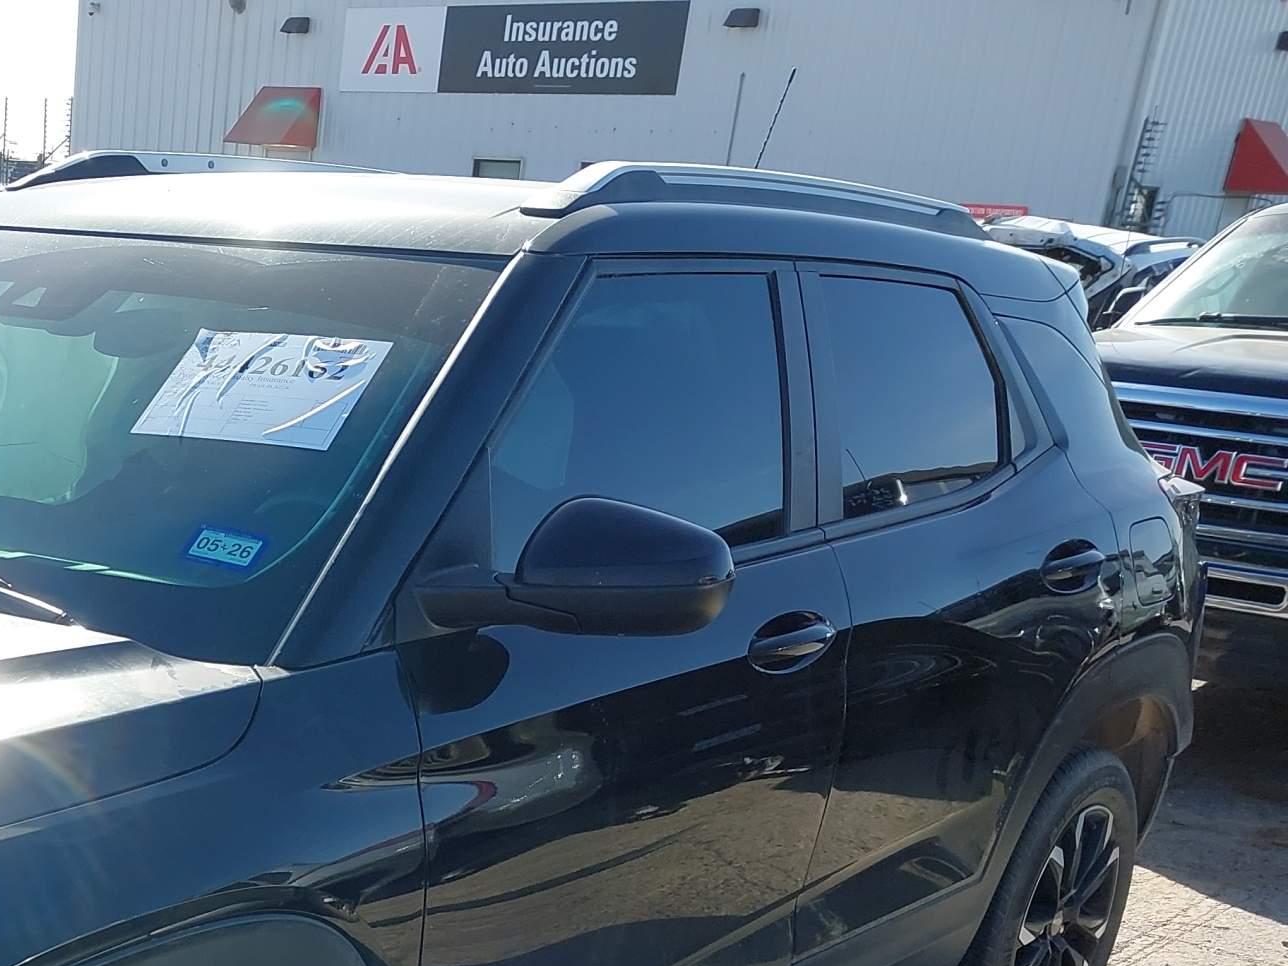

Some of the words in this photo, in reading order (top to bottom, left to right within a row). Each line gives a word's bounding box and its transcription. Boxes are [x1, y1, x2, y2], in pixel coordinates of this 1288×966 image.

[503, 14, 619, 43] Insurance
[475, 50, 529, 79] Auto
[533, 49, 638, 79] Auctions
